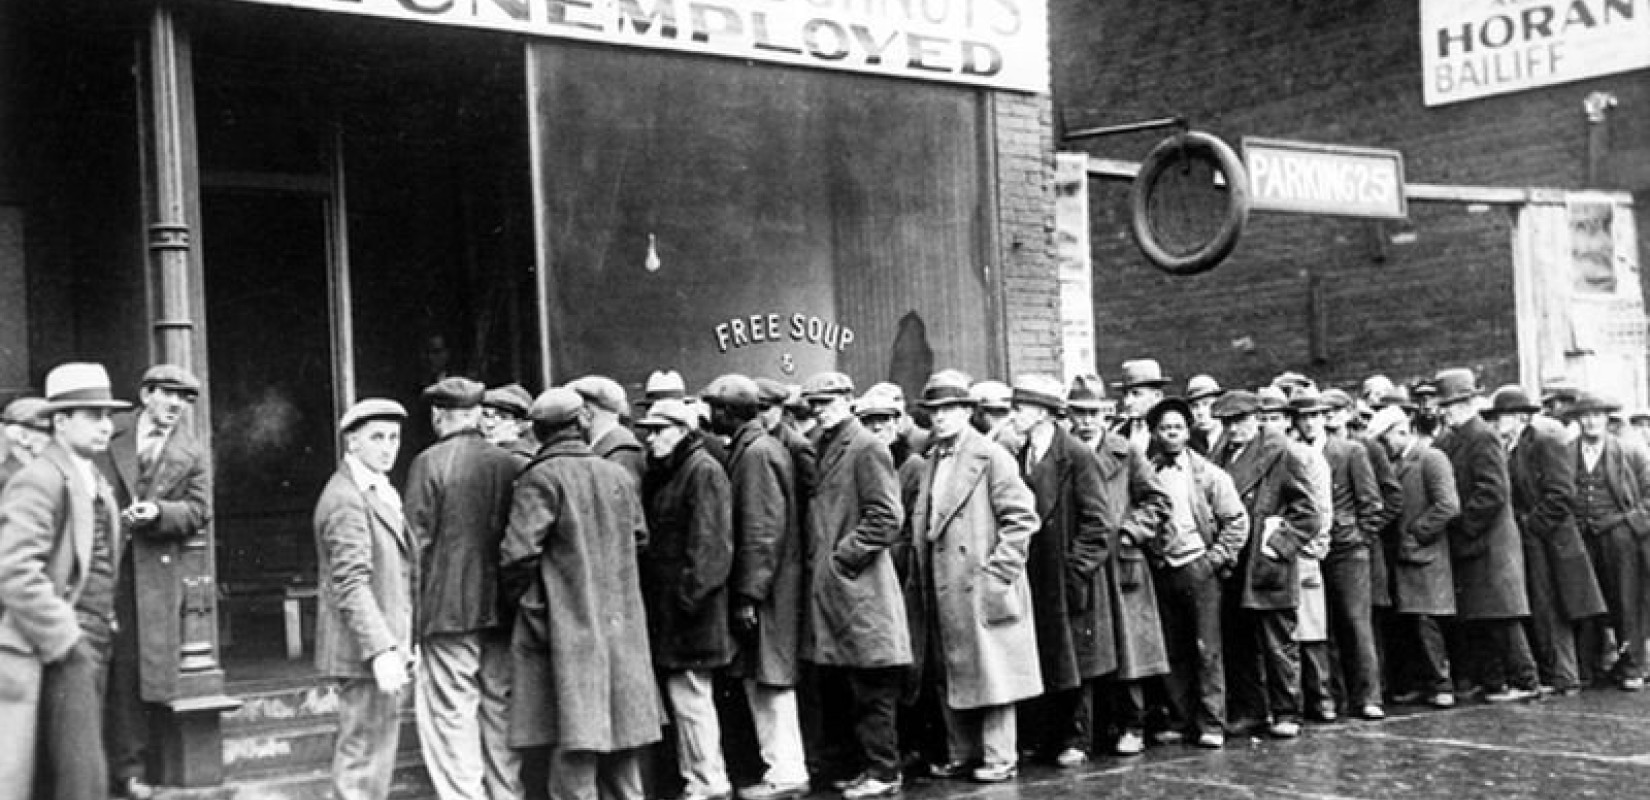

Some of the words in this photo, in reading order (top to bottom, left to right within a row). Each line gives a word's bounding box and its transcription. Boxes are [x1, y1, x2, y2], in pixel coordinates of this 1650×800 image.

[1437, 0, 1634, 58] HORAN
[1435, 41, 1565, 93] BAILIFF
[1251, 153, 1354, 202] PARKING
[714, 314, 782, 354] FREE
[790, 312, 855, 352] SOUP
